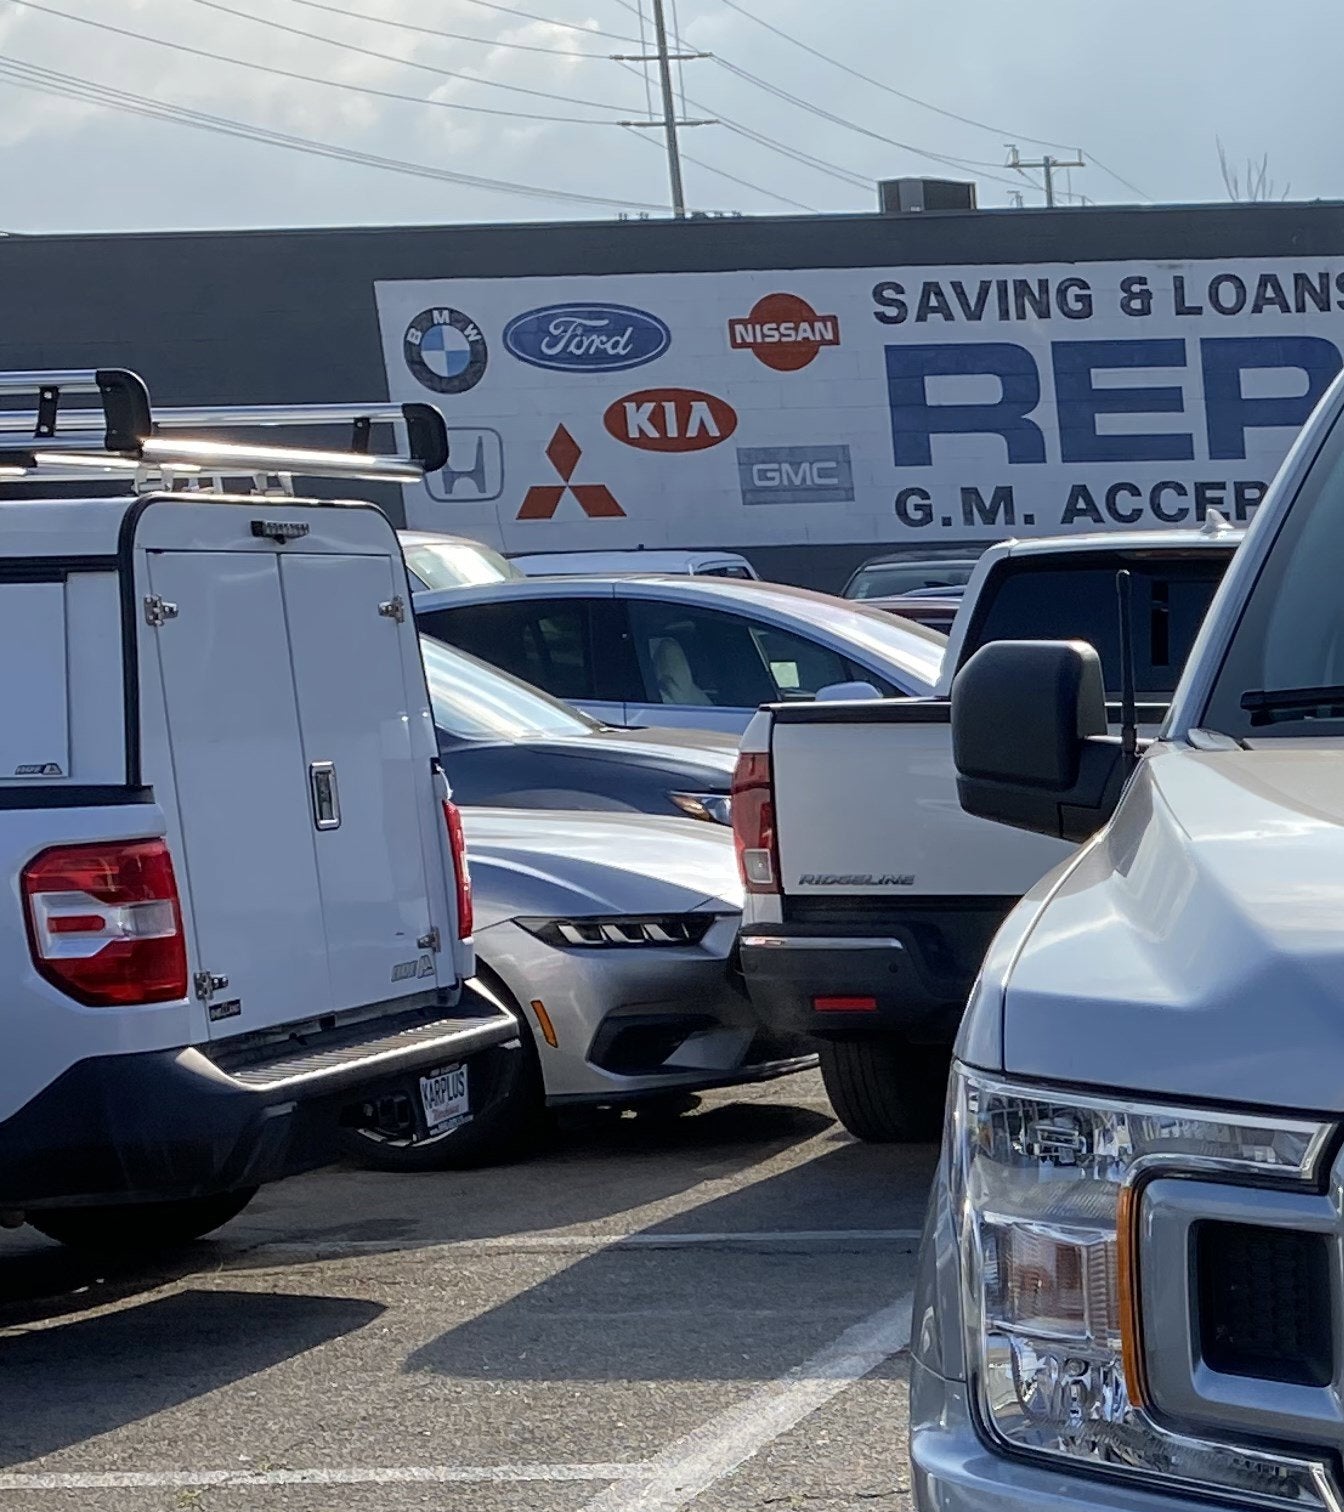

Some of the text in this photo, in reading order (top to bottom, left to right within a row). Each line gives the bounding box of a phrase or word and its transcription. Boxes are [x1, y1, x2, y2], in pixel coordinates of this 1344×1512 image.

[872, 276, 1094, 324] SAVING
[1119, 275, 1154, 317] &
[406, 308, 482, 346] BMW
[539, 316, 634, 357] Ford
[733, 319, 834, 344] NISSAN
[622, 400, 721, 438] KIA
[752, 460, 839, 487] GMC
[894, 484, 1036, 528] G.M.
[799, 873, 916, 886] RIDGELINE
